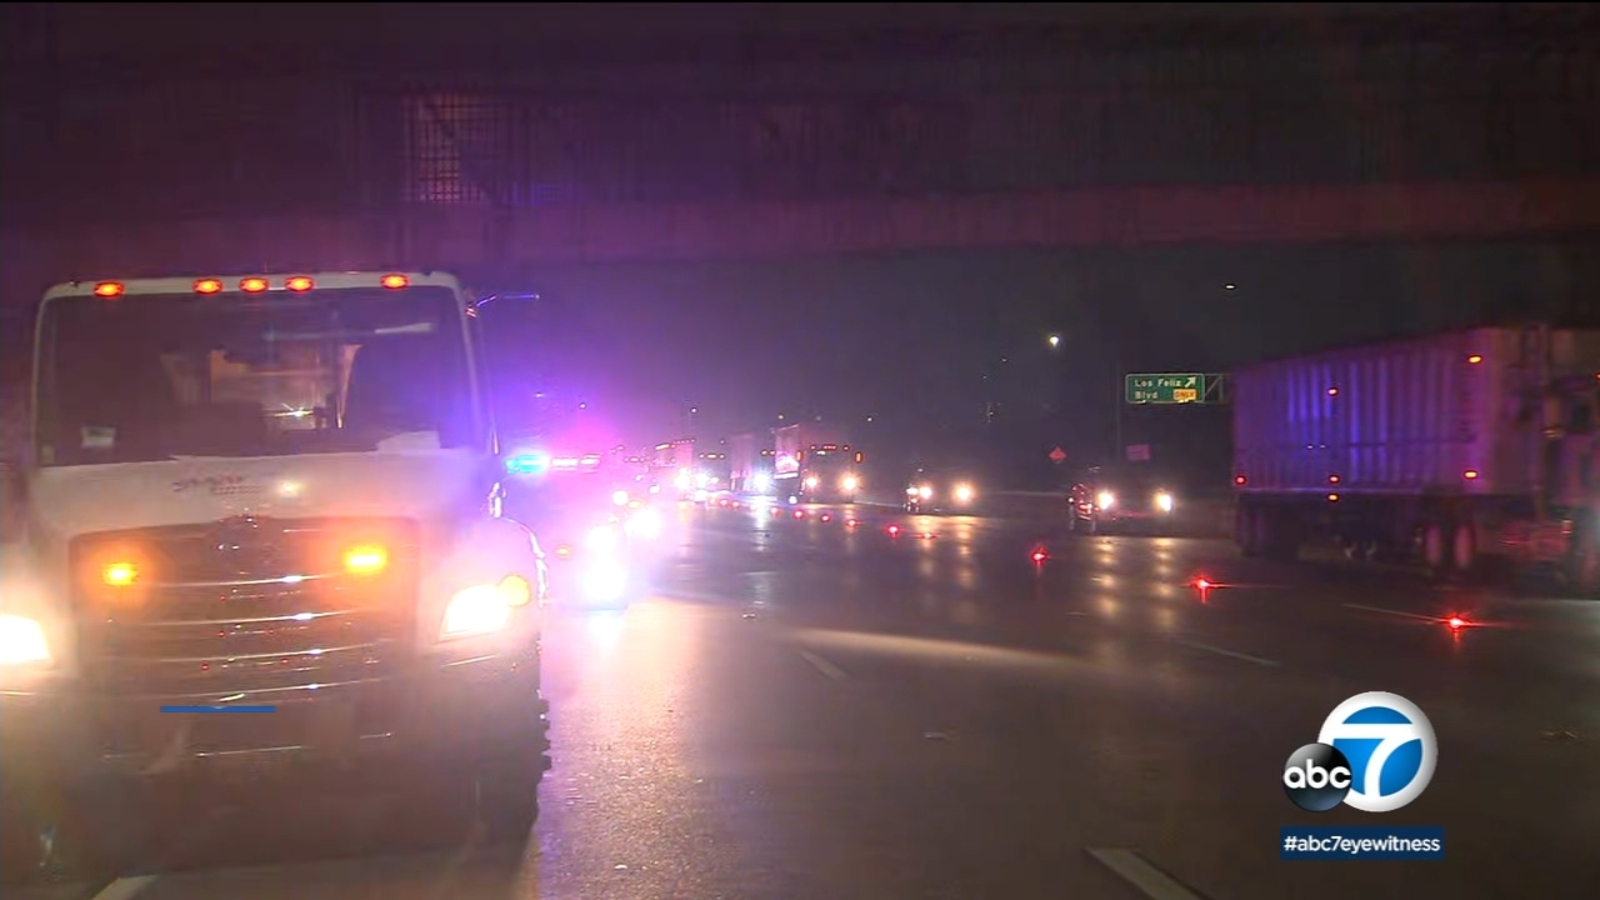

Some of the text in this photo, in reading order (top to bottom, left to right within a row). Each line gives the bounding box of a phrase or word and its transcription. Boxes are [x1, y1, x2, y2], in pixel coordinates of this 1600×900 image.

[1134, 378, 1181, 387] Los Feliz
[1134, 390, 1158, 399] Blvd
[1175, 390, 1196, 398] ONLY
